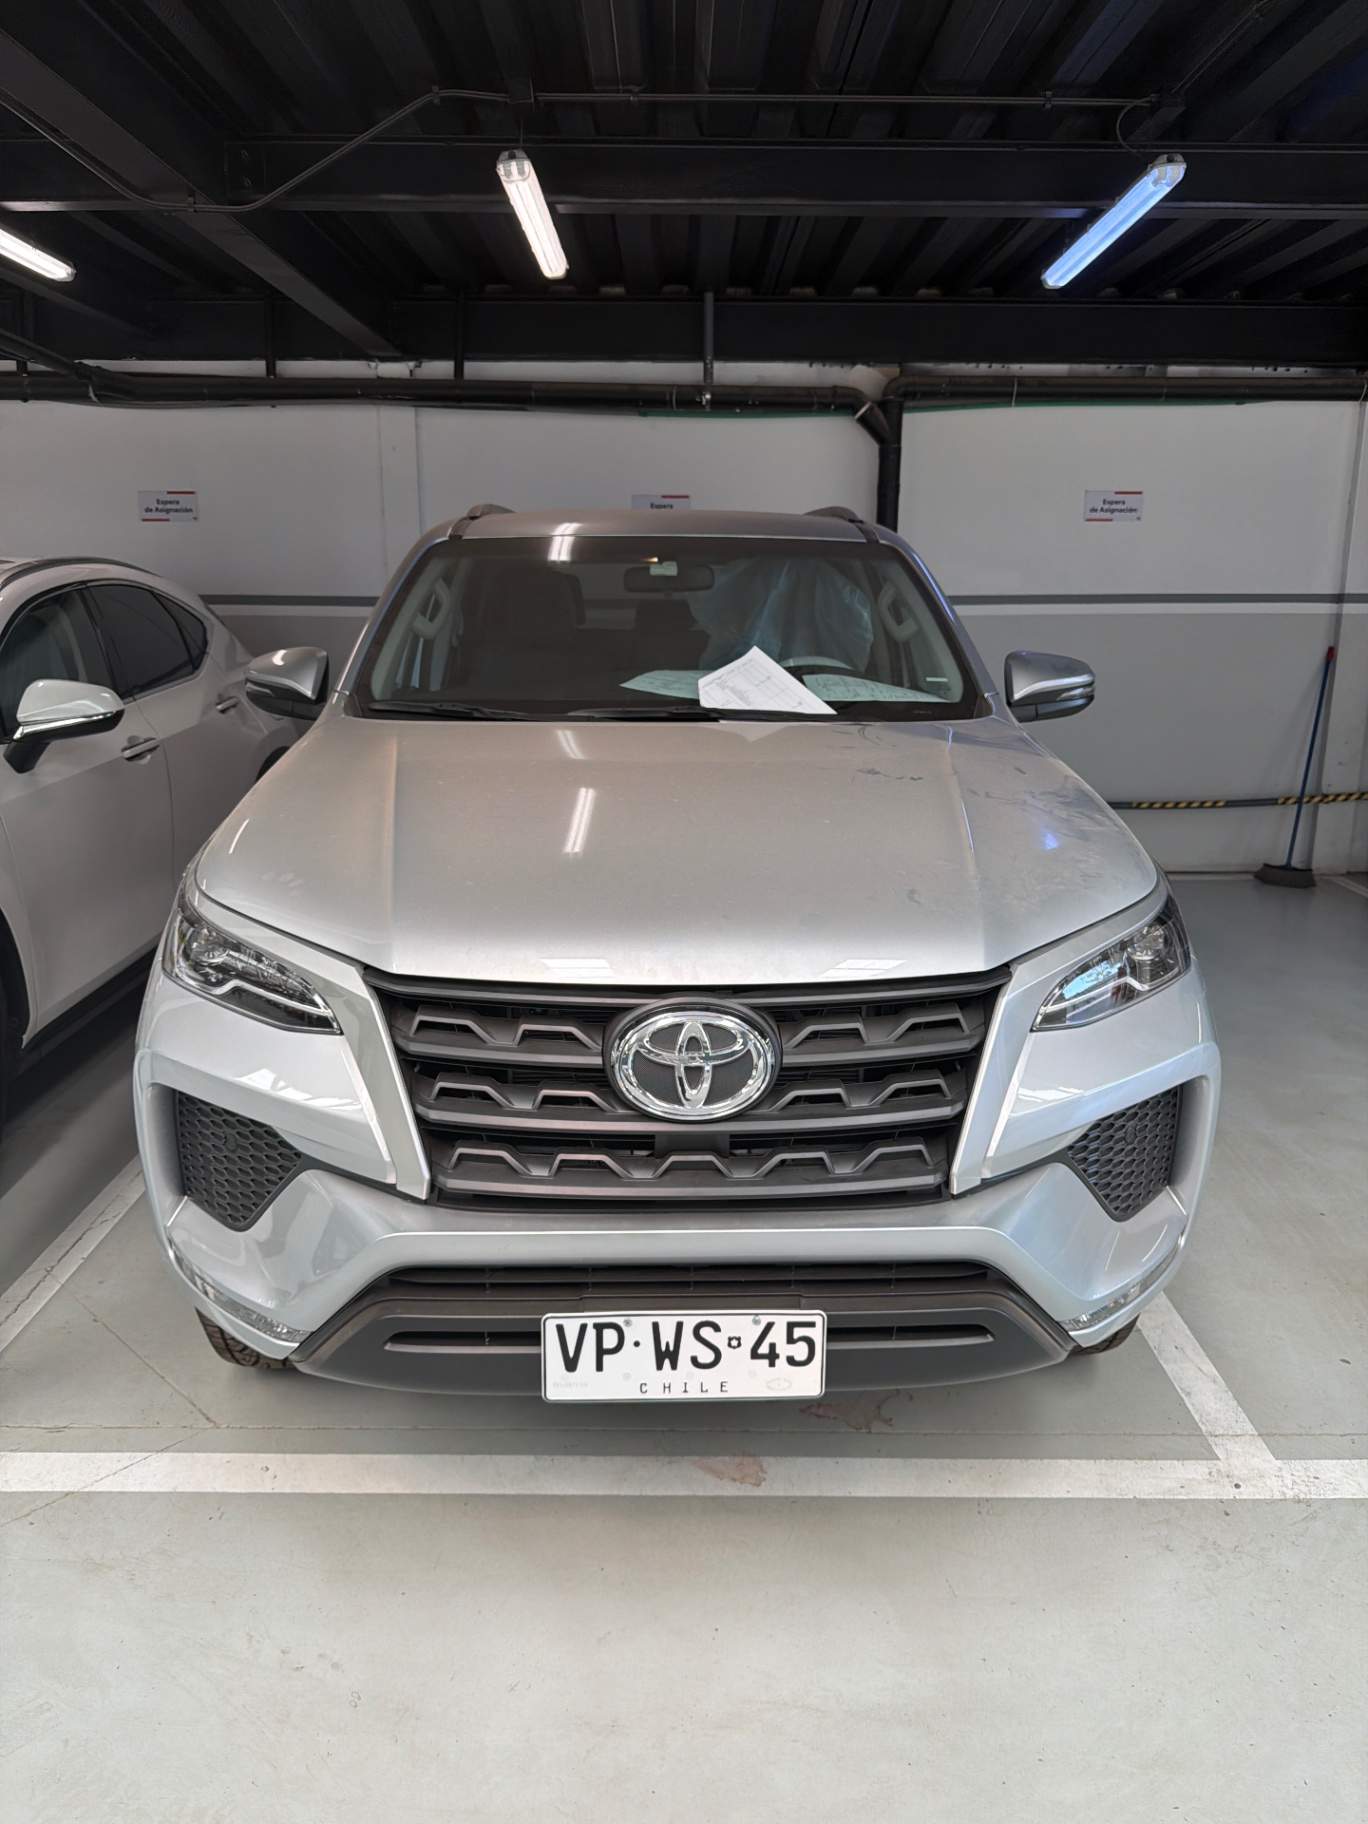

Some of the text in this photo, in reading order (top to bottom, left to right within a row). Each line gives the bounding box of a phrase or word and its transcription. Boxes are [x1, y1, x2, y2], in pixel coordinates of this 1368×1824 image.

[156, 498, 180, 506] Espera
[1102, 498, 1126, 506] Espera
[1100, 506, 1137, 515] Asignación
[639, 1380, 729, 1395] CHILE
